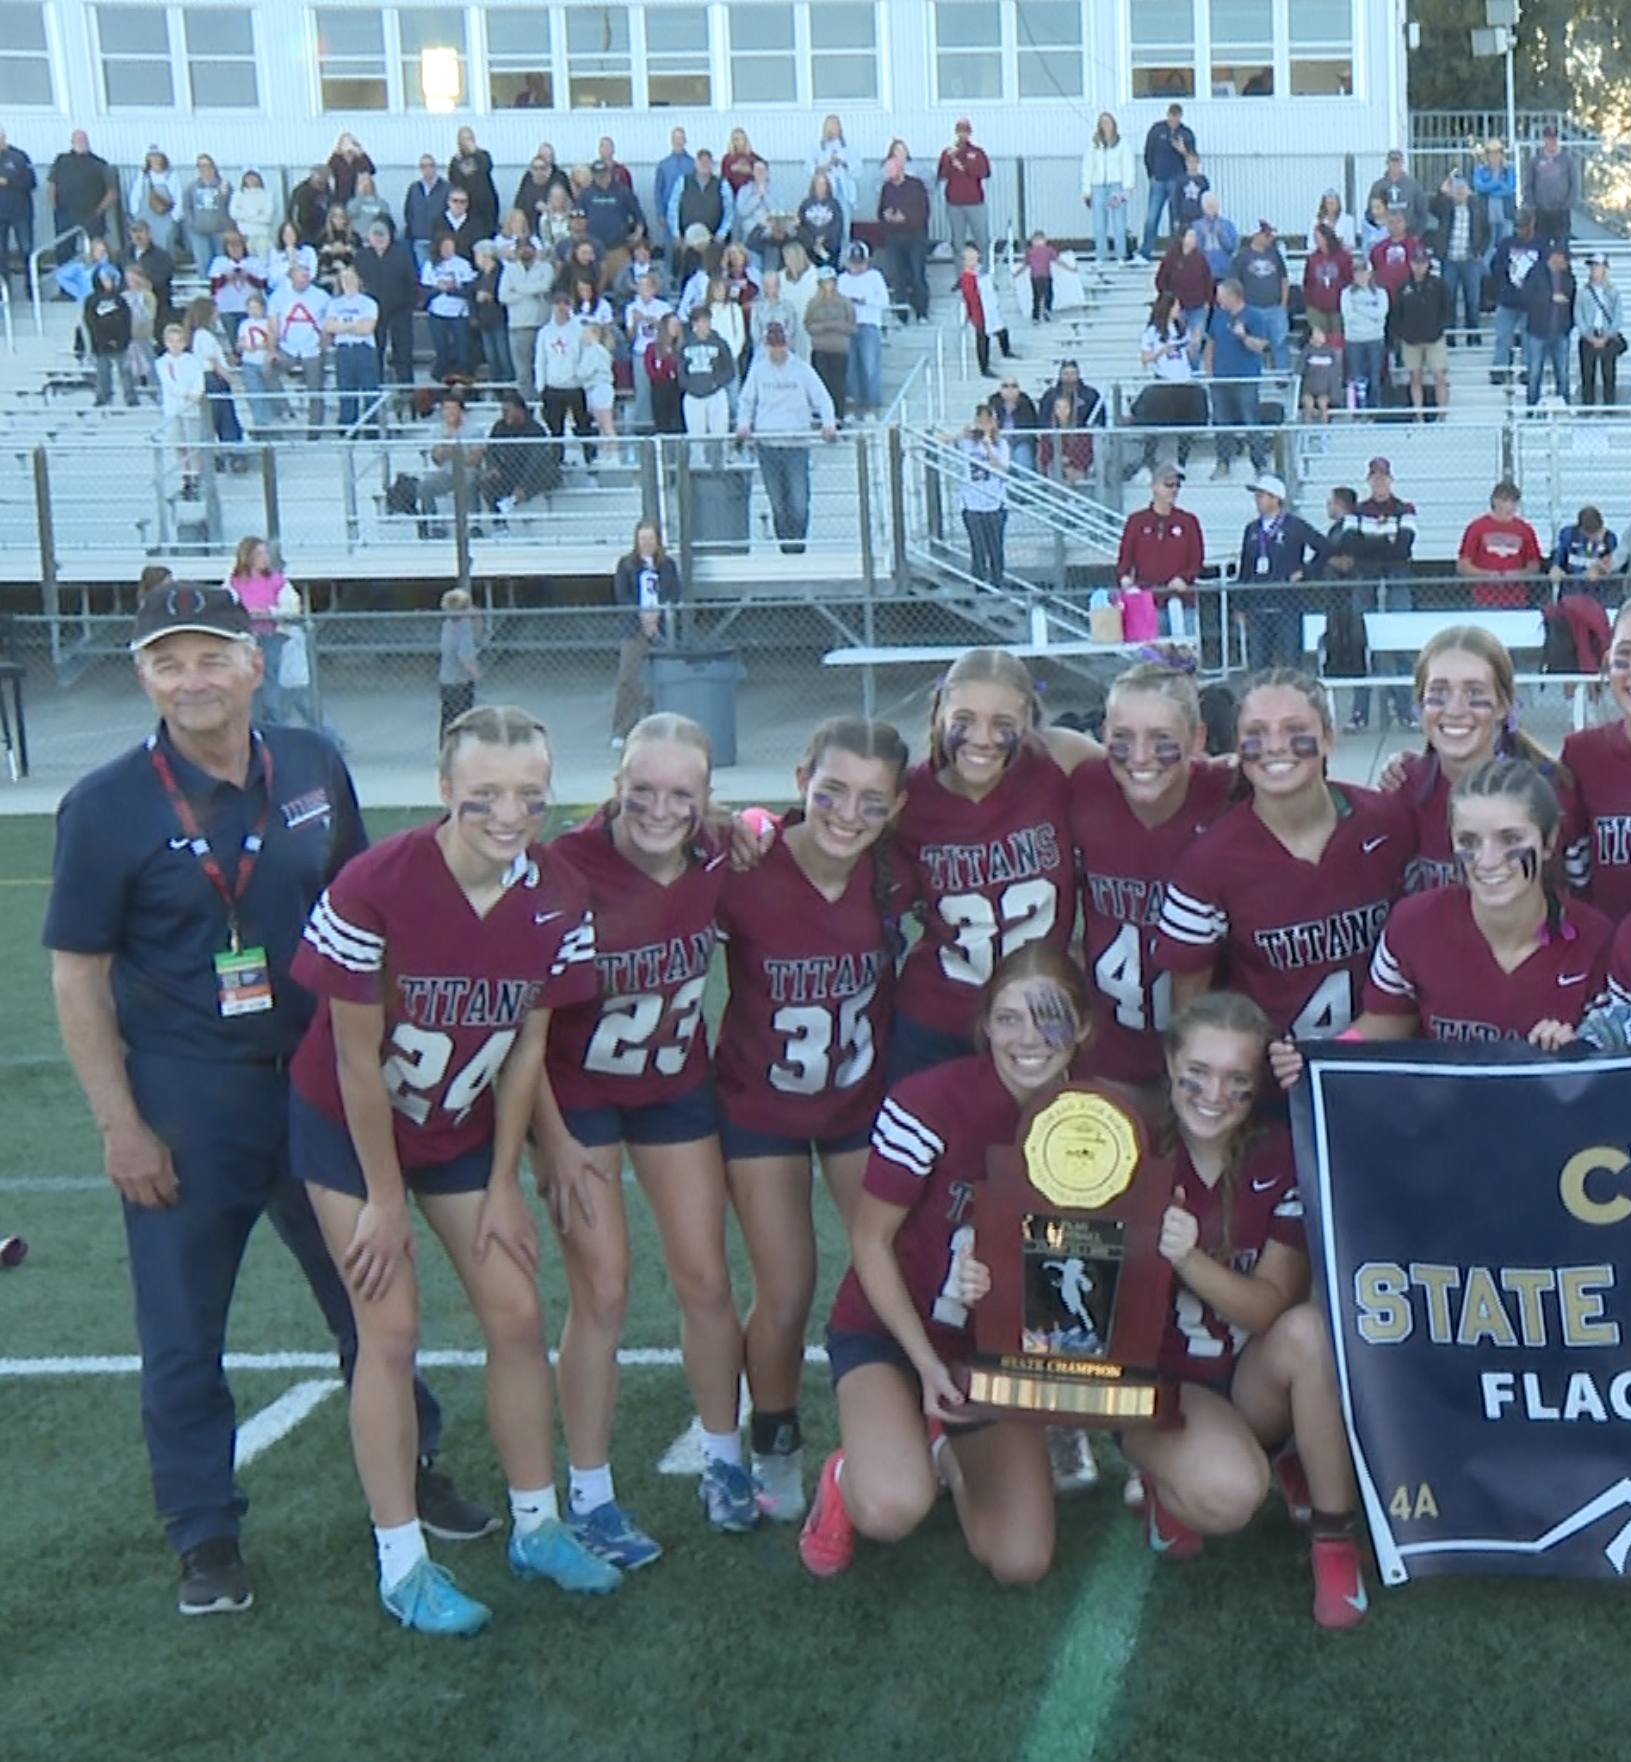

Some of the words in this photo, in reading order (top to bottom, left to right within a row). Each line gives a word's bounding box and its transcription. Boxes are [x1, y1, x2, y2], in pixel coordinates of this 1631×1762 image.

[920, 822, 1060, 890] TITANS
[938, 877, 1057, 987] 32
[1254, 900, 1389, 971] TITANS
[583, 975, 706, 1076] 23
[768, 981, 876, 1095] 35
[382, 1022, 518, 1126] 24
[1355, 1262, 1620, 1347] STATE
[1388, 1482, 1439, 1521] 4A
